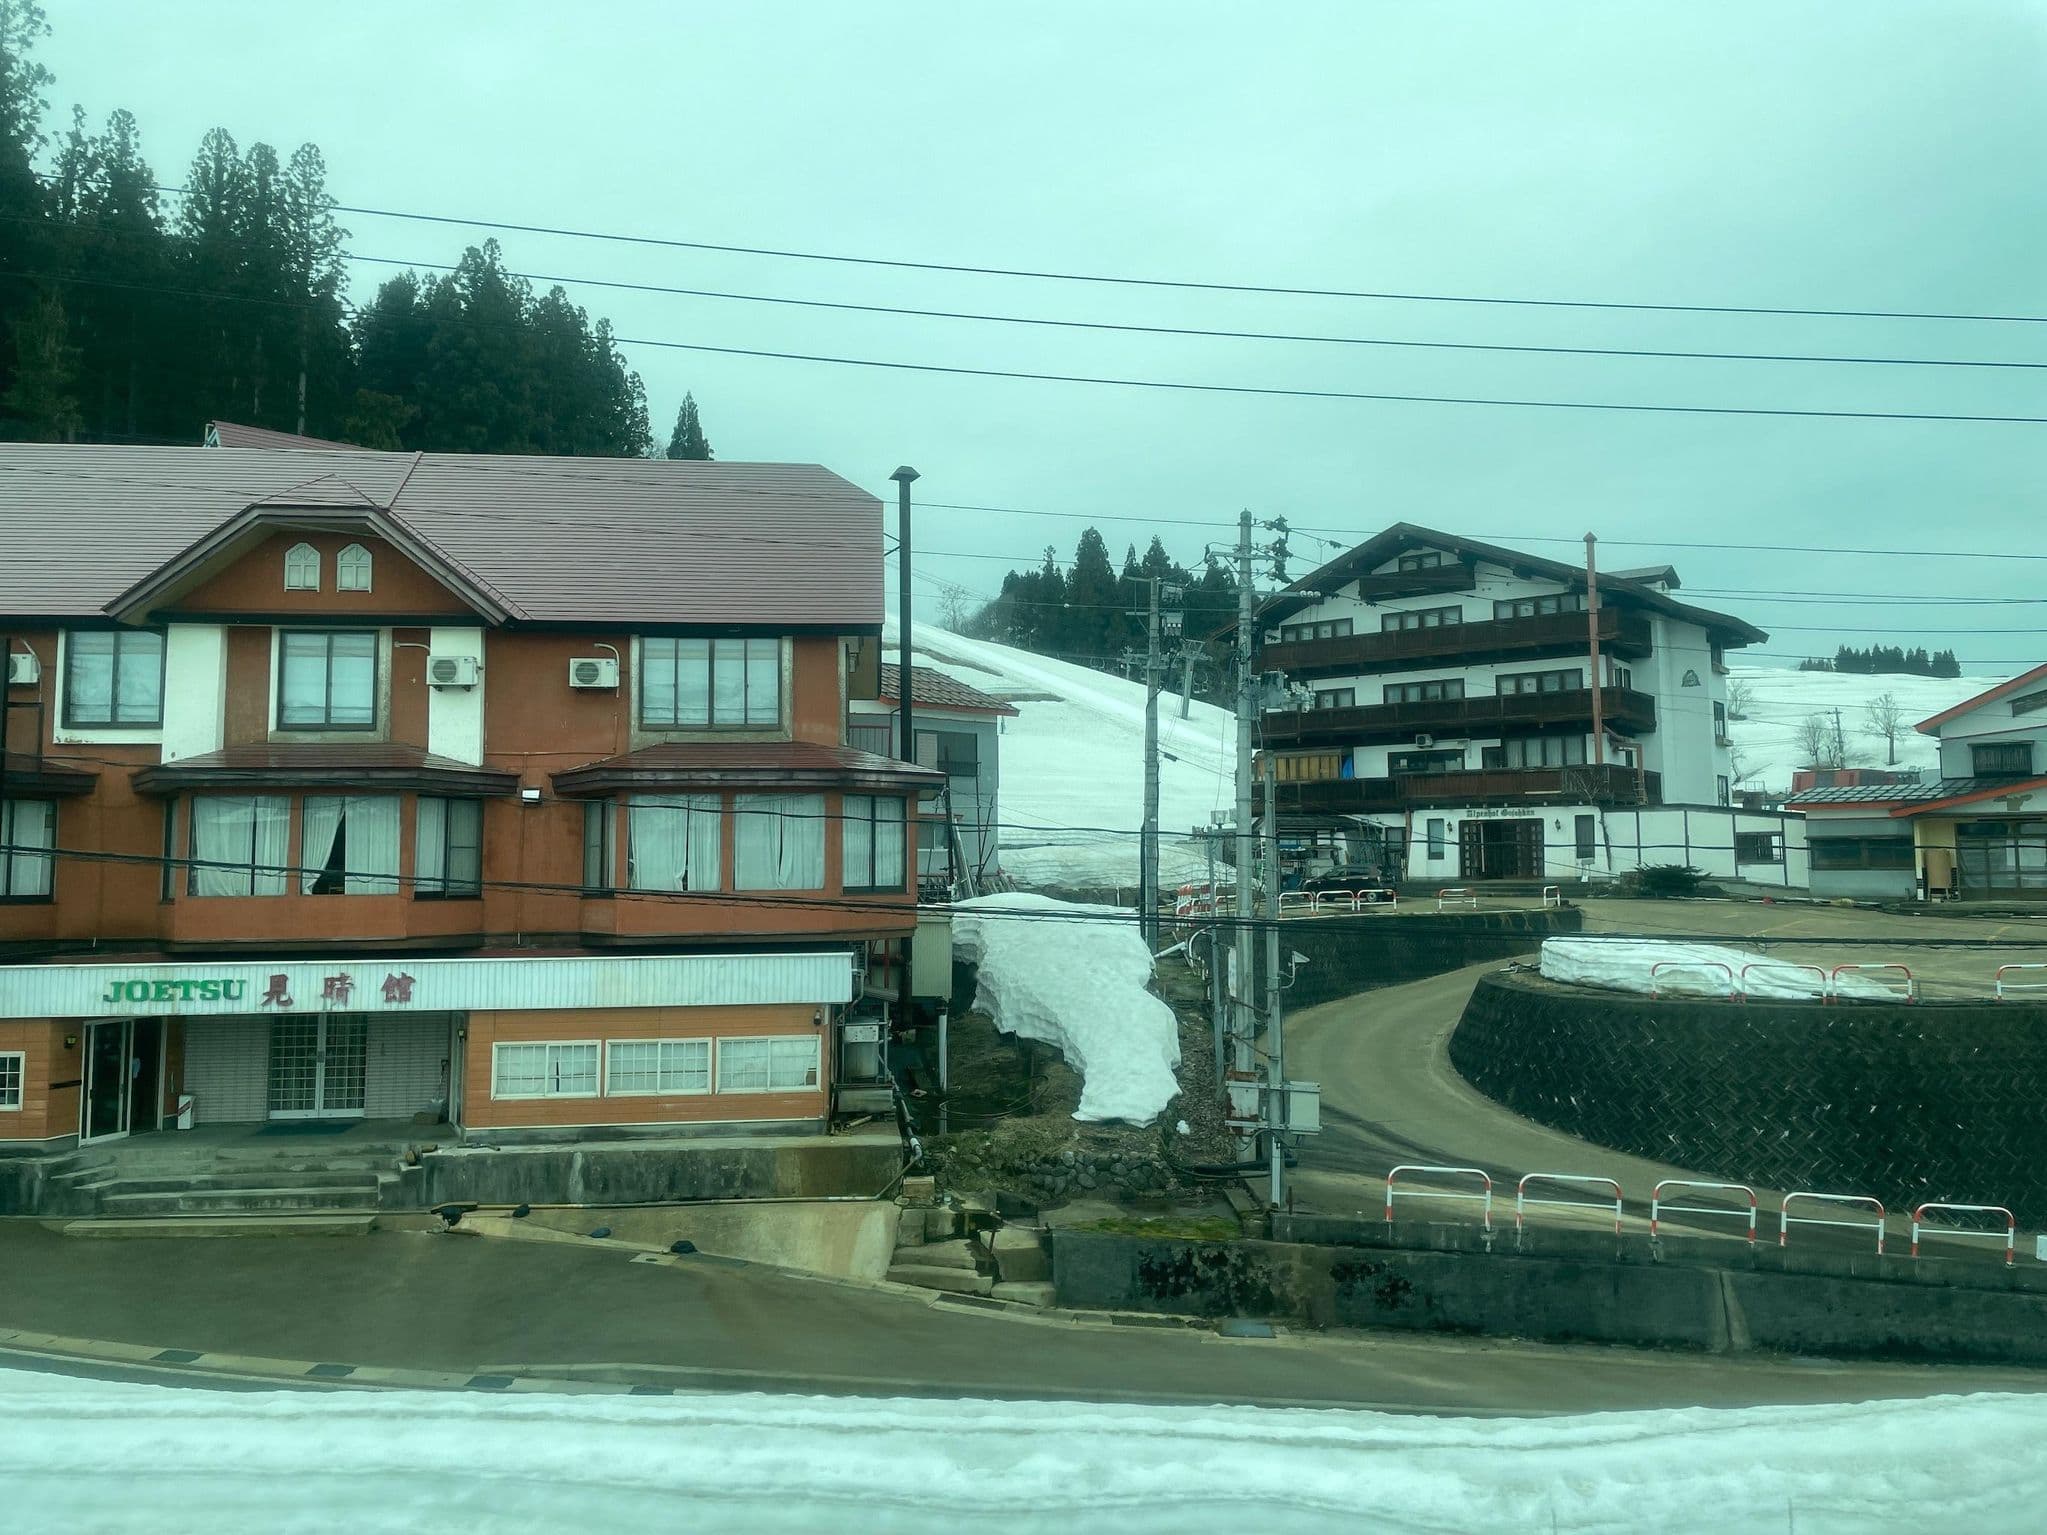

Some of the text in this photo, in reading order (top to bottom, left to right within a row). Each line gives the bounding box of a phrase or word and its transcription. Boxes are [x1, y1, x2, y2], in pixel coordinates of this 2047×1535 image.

[103, 972, 416, 1006] JOETSU 見晴館
